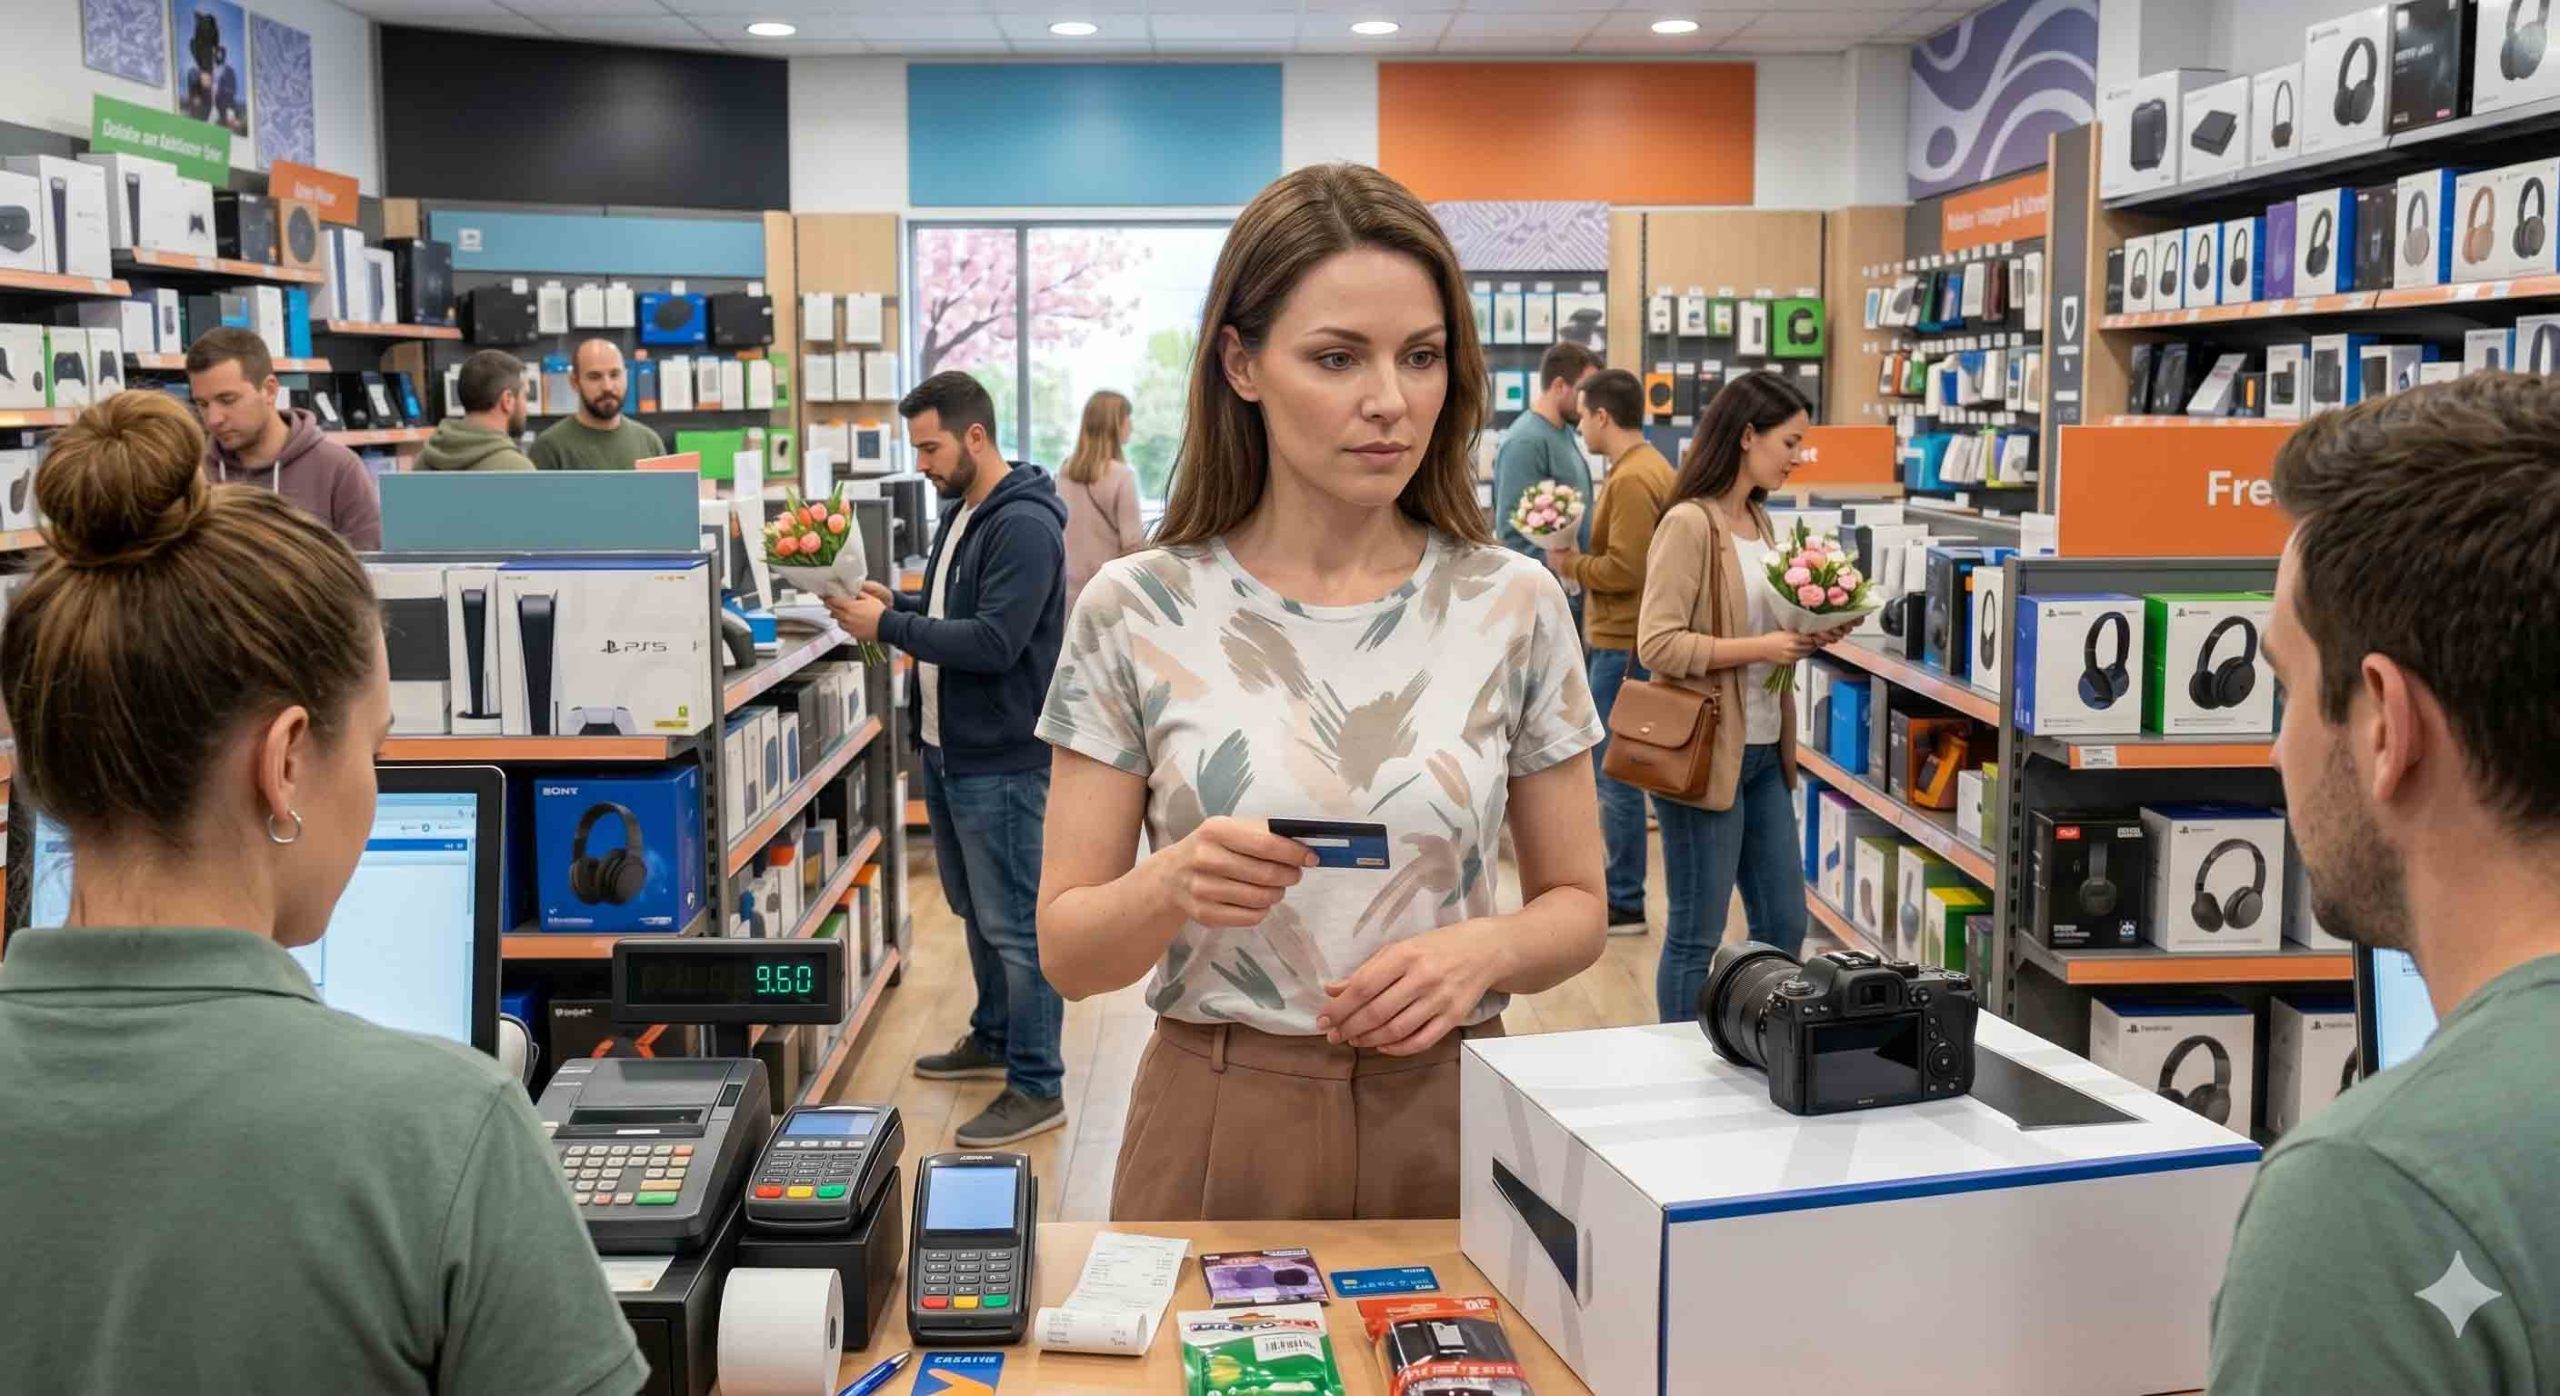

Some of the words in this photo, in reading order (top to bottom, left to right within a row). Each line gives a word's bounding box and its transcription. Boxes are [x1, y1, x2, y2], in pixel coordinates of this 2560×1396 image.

[2207, 470, 2273, 506] Fre
[624, 641, 668, 653] PS5
[756, 965, 812, 993] 9.60
